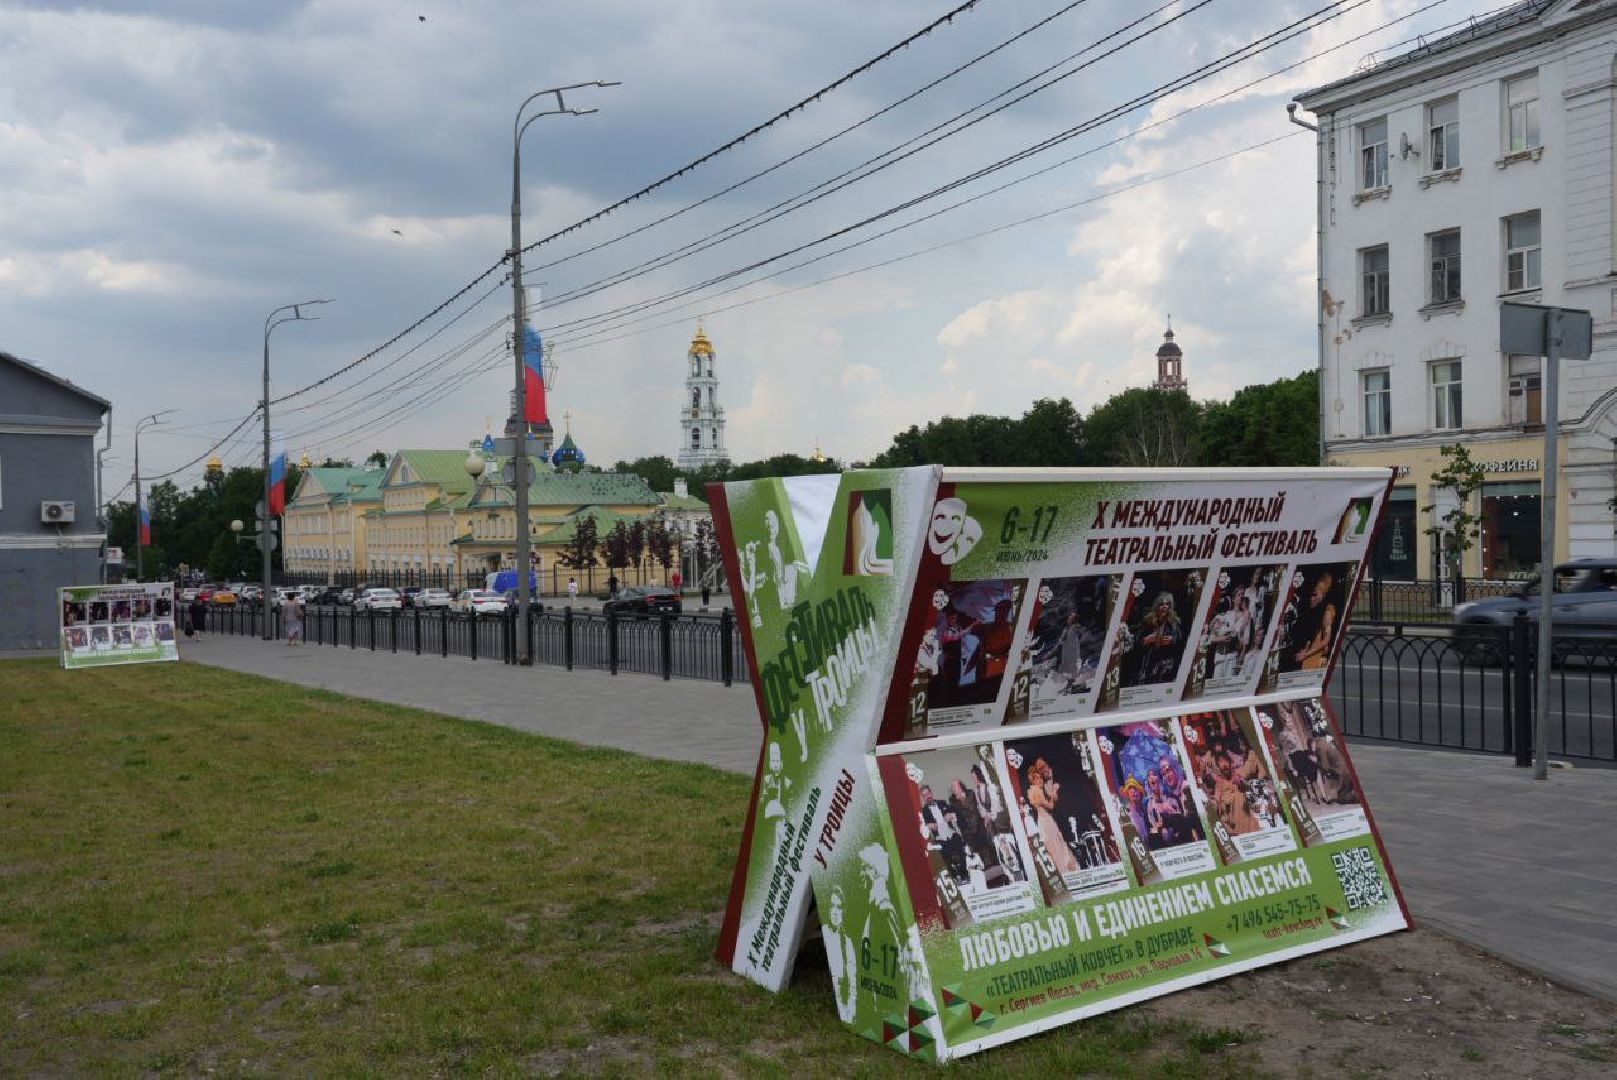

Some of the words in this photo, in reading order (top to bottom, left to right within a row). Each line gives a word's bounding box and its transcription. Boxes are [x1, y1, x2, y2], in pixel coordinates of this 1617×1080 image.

[1000, 505, 1059, 544] 6-17
[1111, 491, 1286, 531] МЕЖДУНАРОДНЫЙ
[1084, 528, 1219, 566] ТЕАТРАЛЬНЫЙ
[1220, 528, 1318, 559] ФЕСТИВАЛЬ
[1013, 676, 1029, 702] 12
[1106, 666, 1120, 690] 13
[1192, 658, 1207, 683] 13
[910, 692, 926, 719] 12
[819, 768, 856, 851] ТРОИЦЫ
[936, 869, 958, 904] 15
[959, 914, 1071, 972] ЛЮБОВЬЮ
[1072, 909, 1092, 942] И
[1093, 880, 1215, 940] ЕДИНЕНИЕМ
[1214, 857, 1312, 906] СПАСЕМСЯ
[986, 952, 1080, 998] «ТЕАТРАЛЬНЫЙ
[1135, 940, 1145, 959] В
[1148, 926, 1195, 957] ДУБРАВЕ
